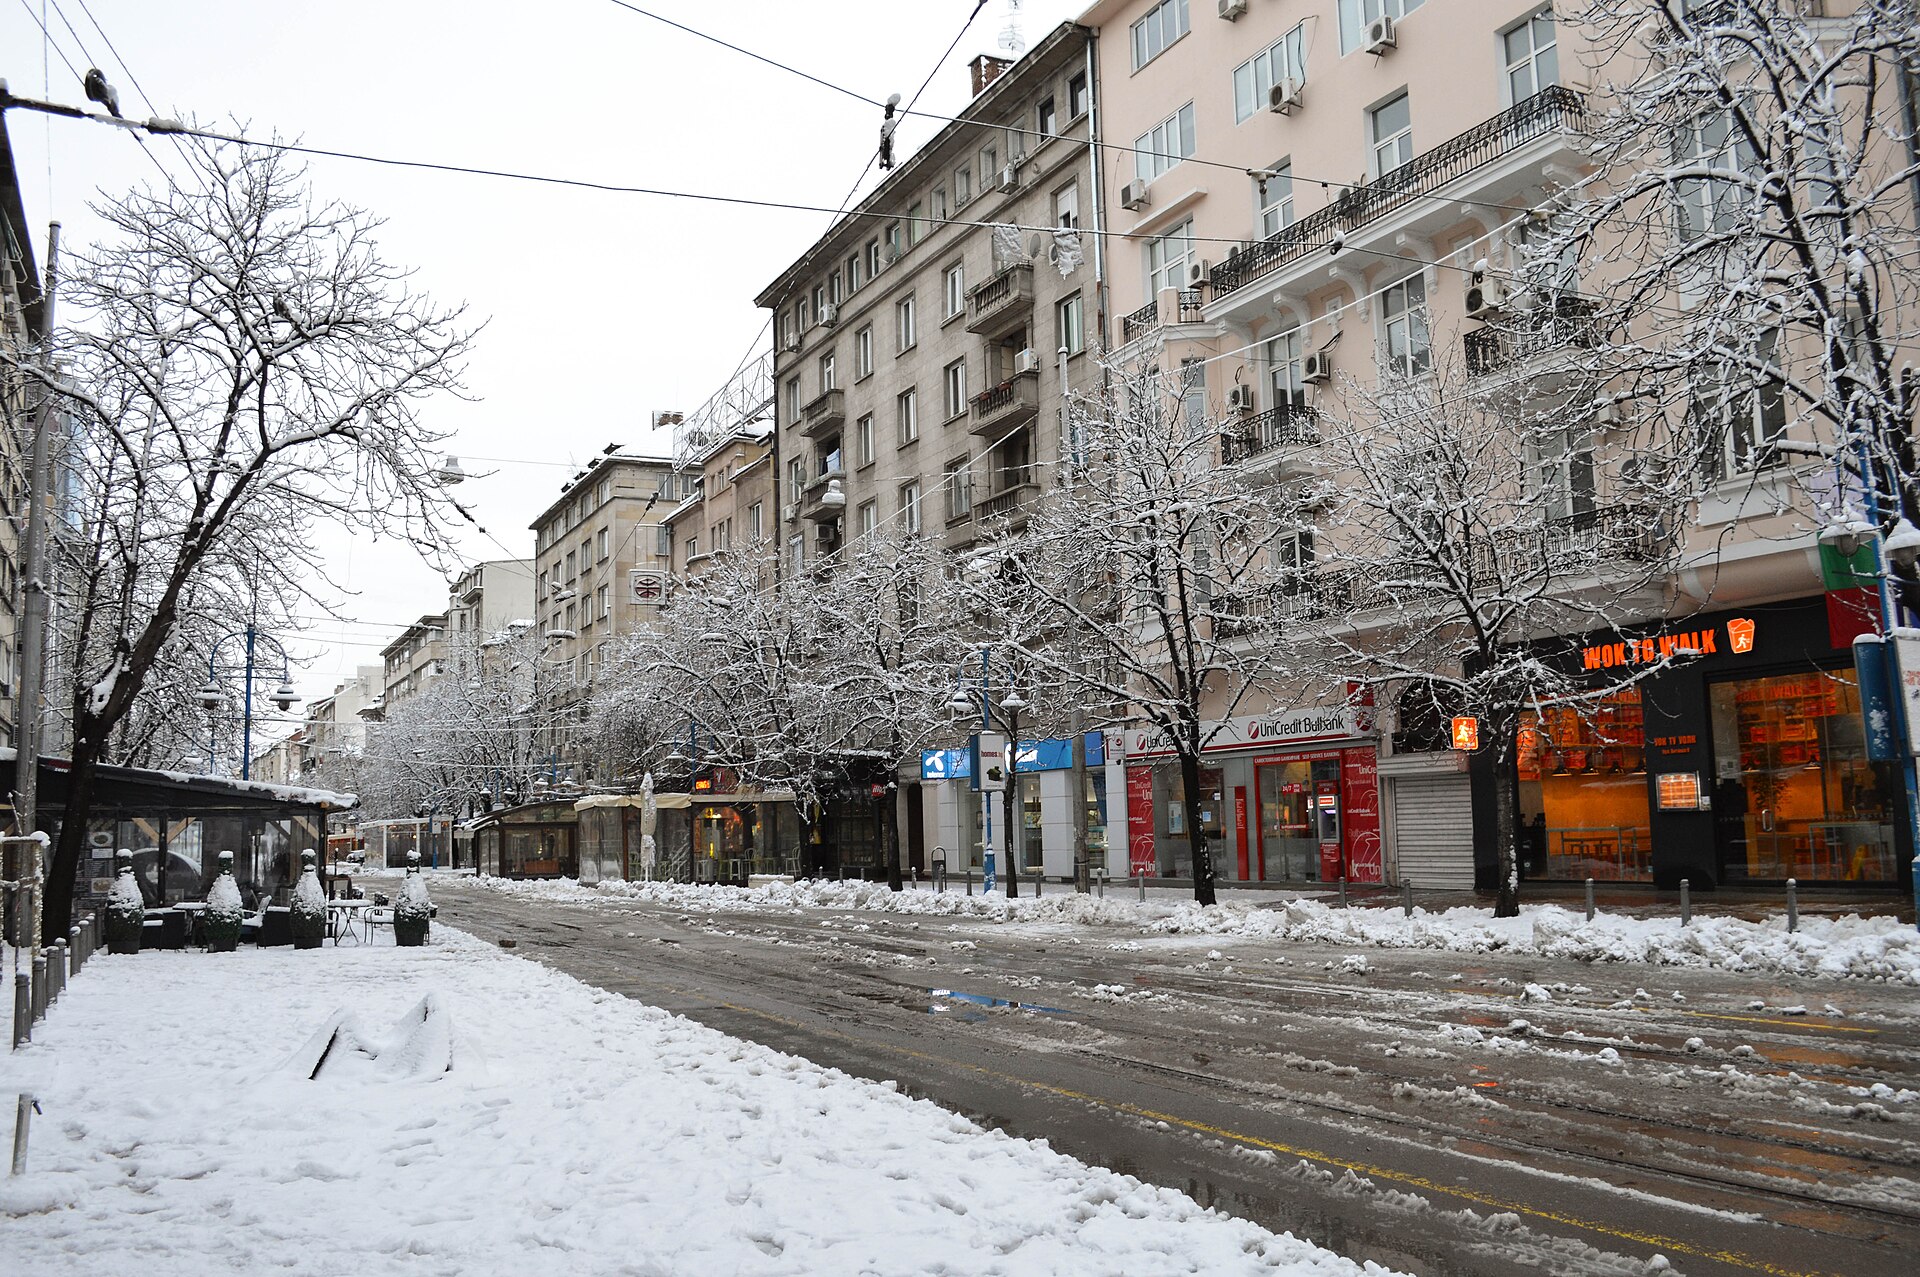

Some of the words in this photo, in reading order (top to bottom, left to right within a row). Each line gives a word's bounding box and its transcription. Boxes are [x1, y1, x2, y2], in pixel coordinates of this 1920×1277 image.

[1583, 643, 1626, 670] WOK
[1633, 638, 1655, 664] TO
[1659, 629, 1717, 659] WALK
[1260, 719, 1302, 738] UniCredit
[1304, 715, 1345, 733] Bulbank
